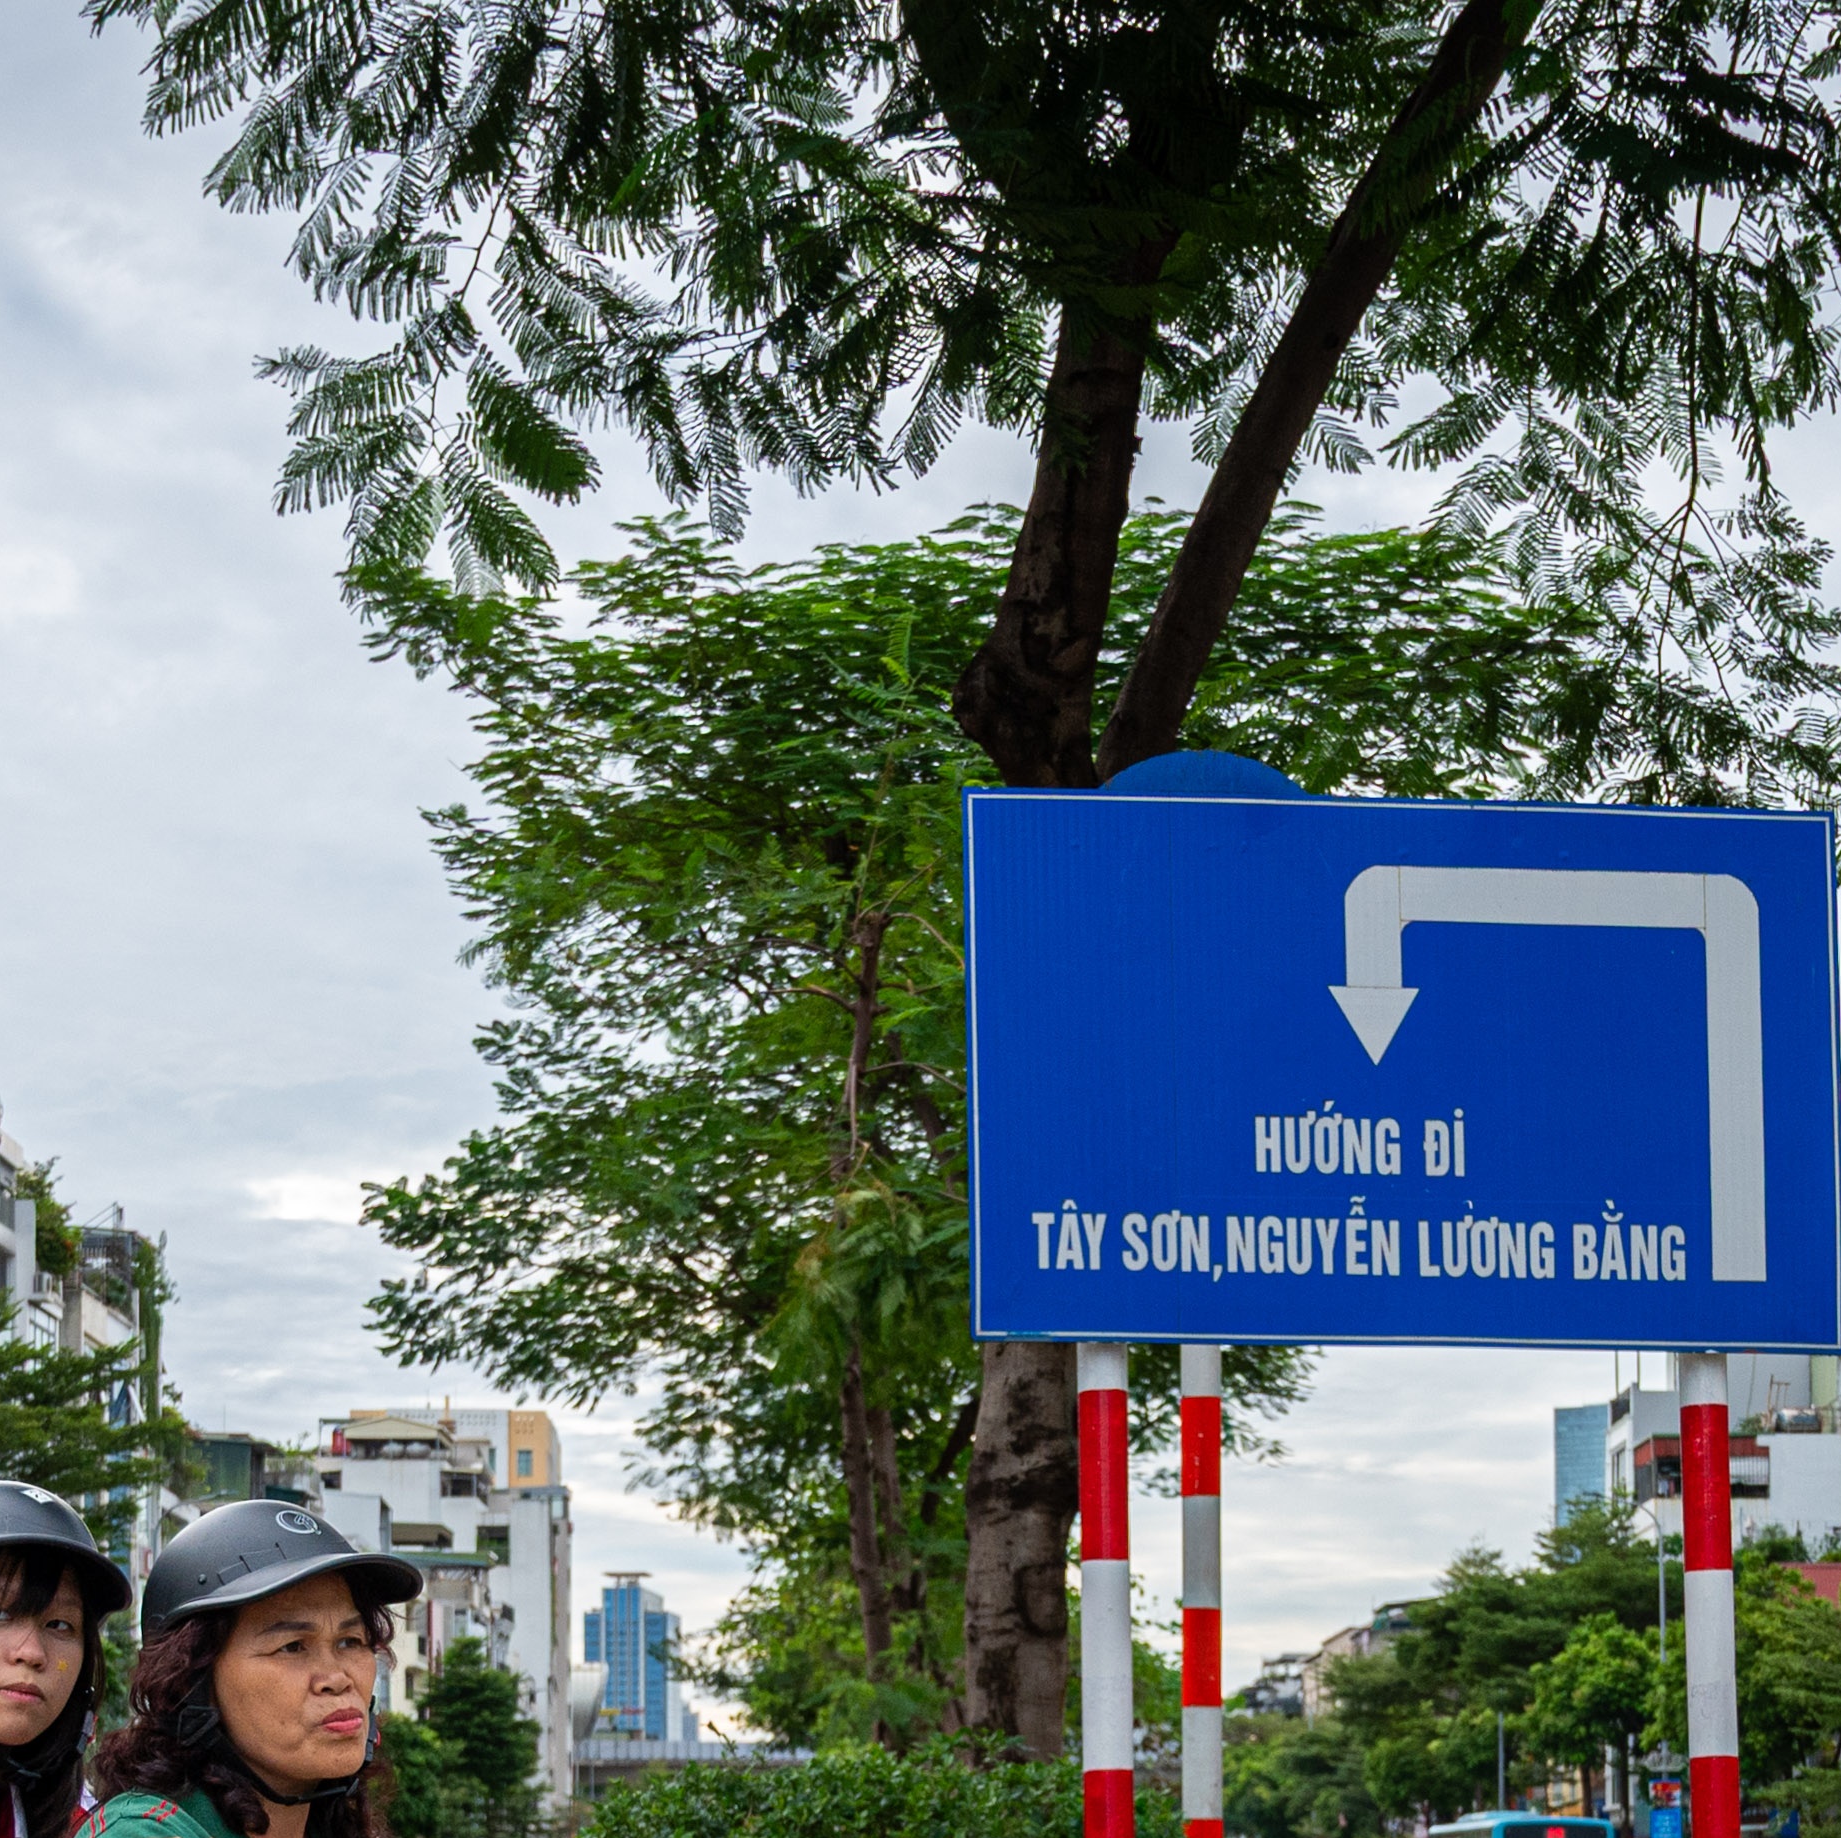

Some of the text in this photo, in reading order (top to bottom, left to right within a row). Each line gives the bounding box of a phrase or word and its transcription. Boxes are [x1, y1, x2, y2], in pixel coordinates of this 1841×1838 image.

[1255, 1100, 1401, 1175] HƯỚNG
[1032, 1199, 1106, 1270] TÂY
[1573, 1200, 1686, 1281] BẰNG
